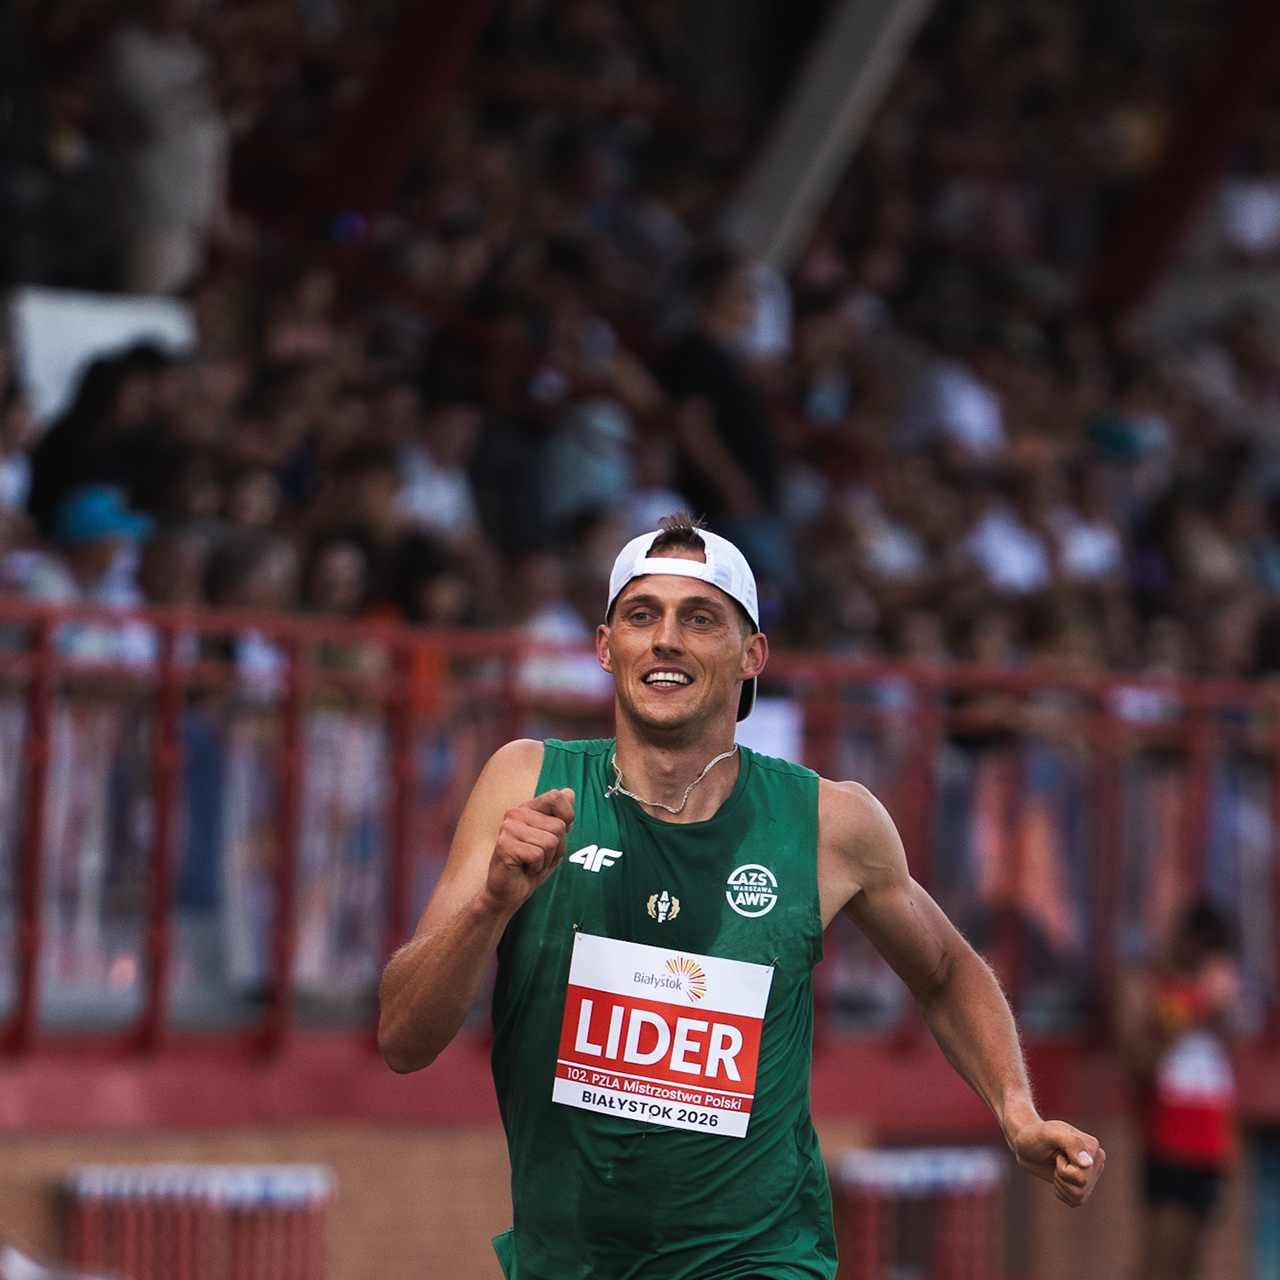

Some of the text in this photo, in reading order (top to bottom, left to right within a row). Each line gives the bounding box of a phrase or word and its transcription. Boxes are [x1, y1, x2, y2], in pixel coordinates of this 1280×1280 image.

[569, 844, 623, 873] 4F
[733, 885, 773, 893] WARSZAWA
[738, 872, 768, 886] AZS
[657, 890, 671, 923] AWF
[735, 891, 769, 906] AWF
[633, 971, 682, 991] Białystok
[574, 998, 743, 1082] LIDER
[567, 1067, 742, 1110] 102. PZLA Mistrzostwa Polski
[581, 1090, 719, 1127] BIAŁYSTOK 2026
